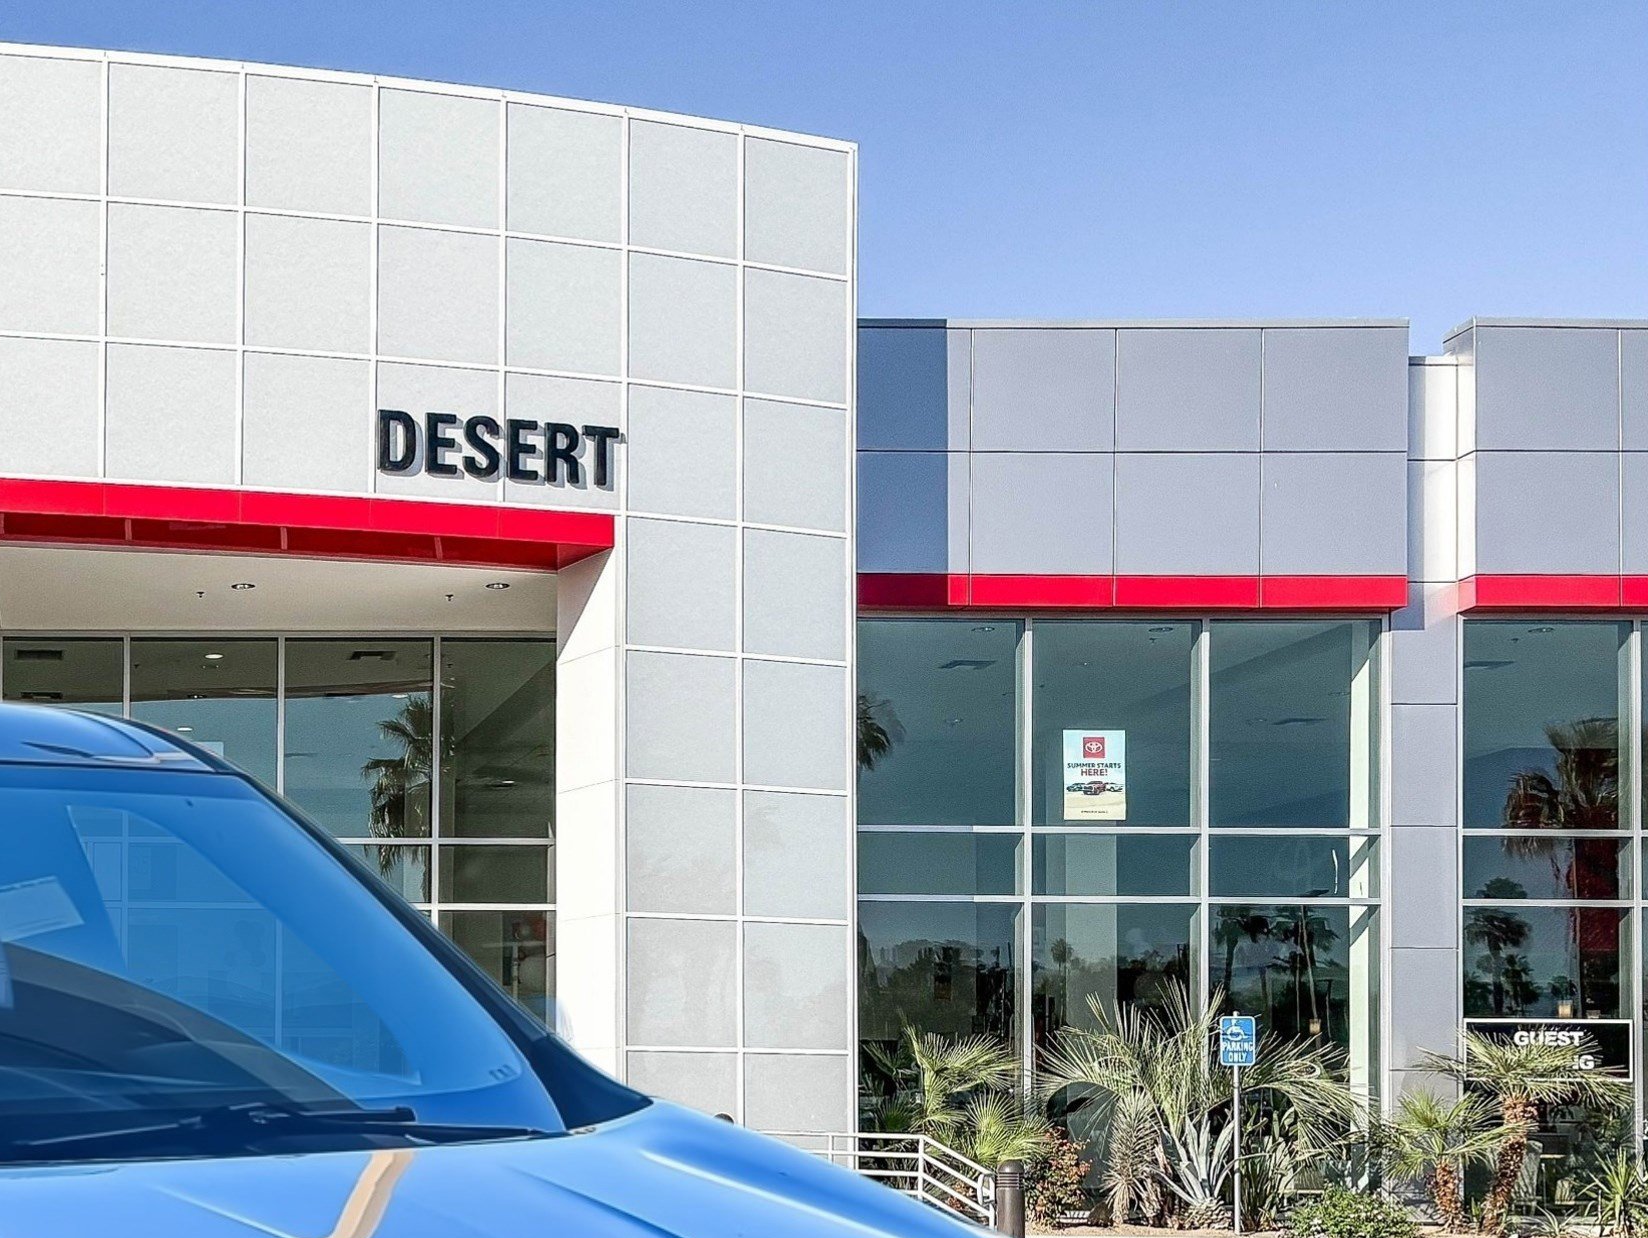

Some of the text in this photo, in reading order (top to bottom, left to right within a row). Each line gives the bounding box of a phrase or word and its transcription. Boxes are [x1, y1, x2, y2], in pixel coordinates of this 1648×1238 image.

[377, 409, 620, 487] DESERT
[1080, 768, 1108, 777] HERE!
[1513, 1030, 1585, 1047] GUEST
[1221, 1041, 1254, 1052] PARKING
[1228, 1051, 1248, 1063] ONLY
